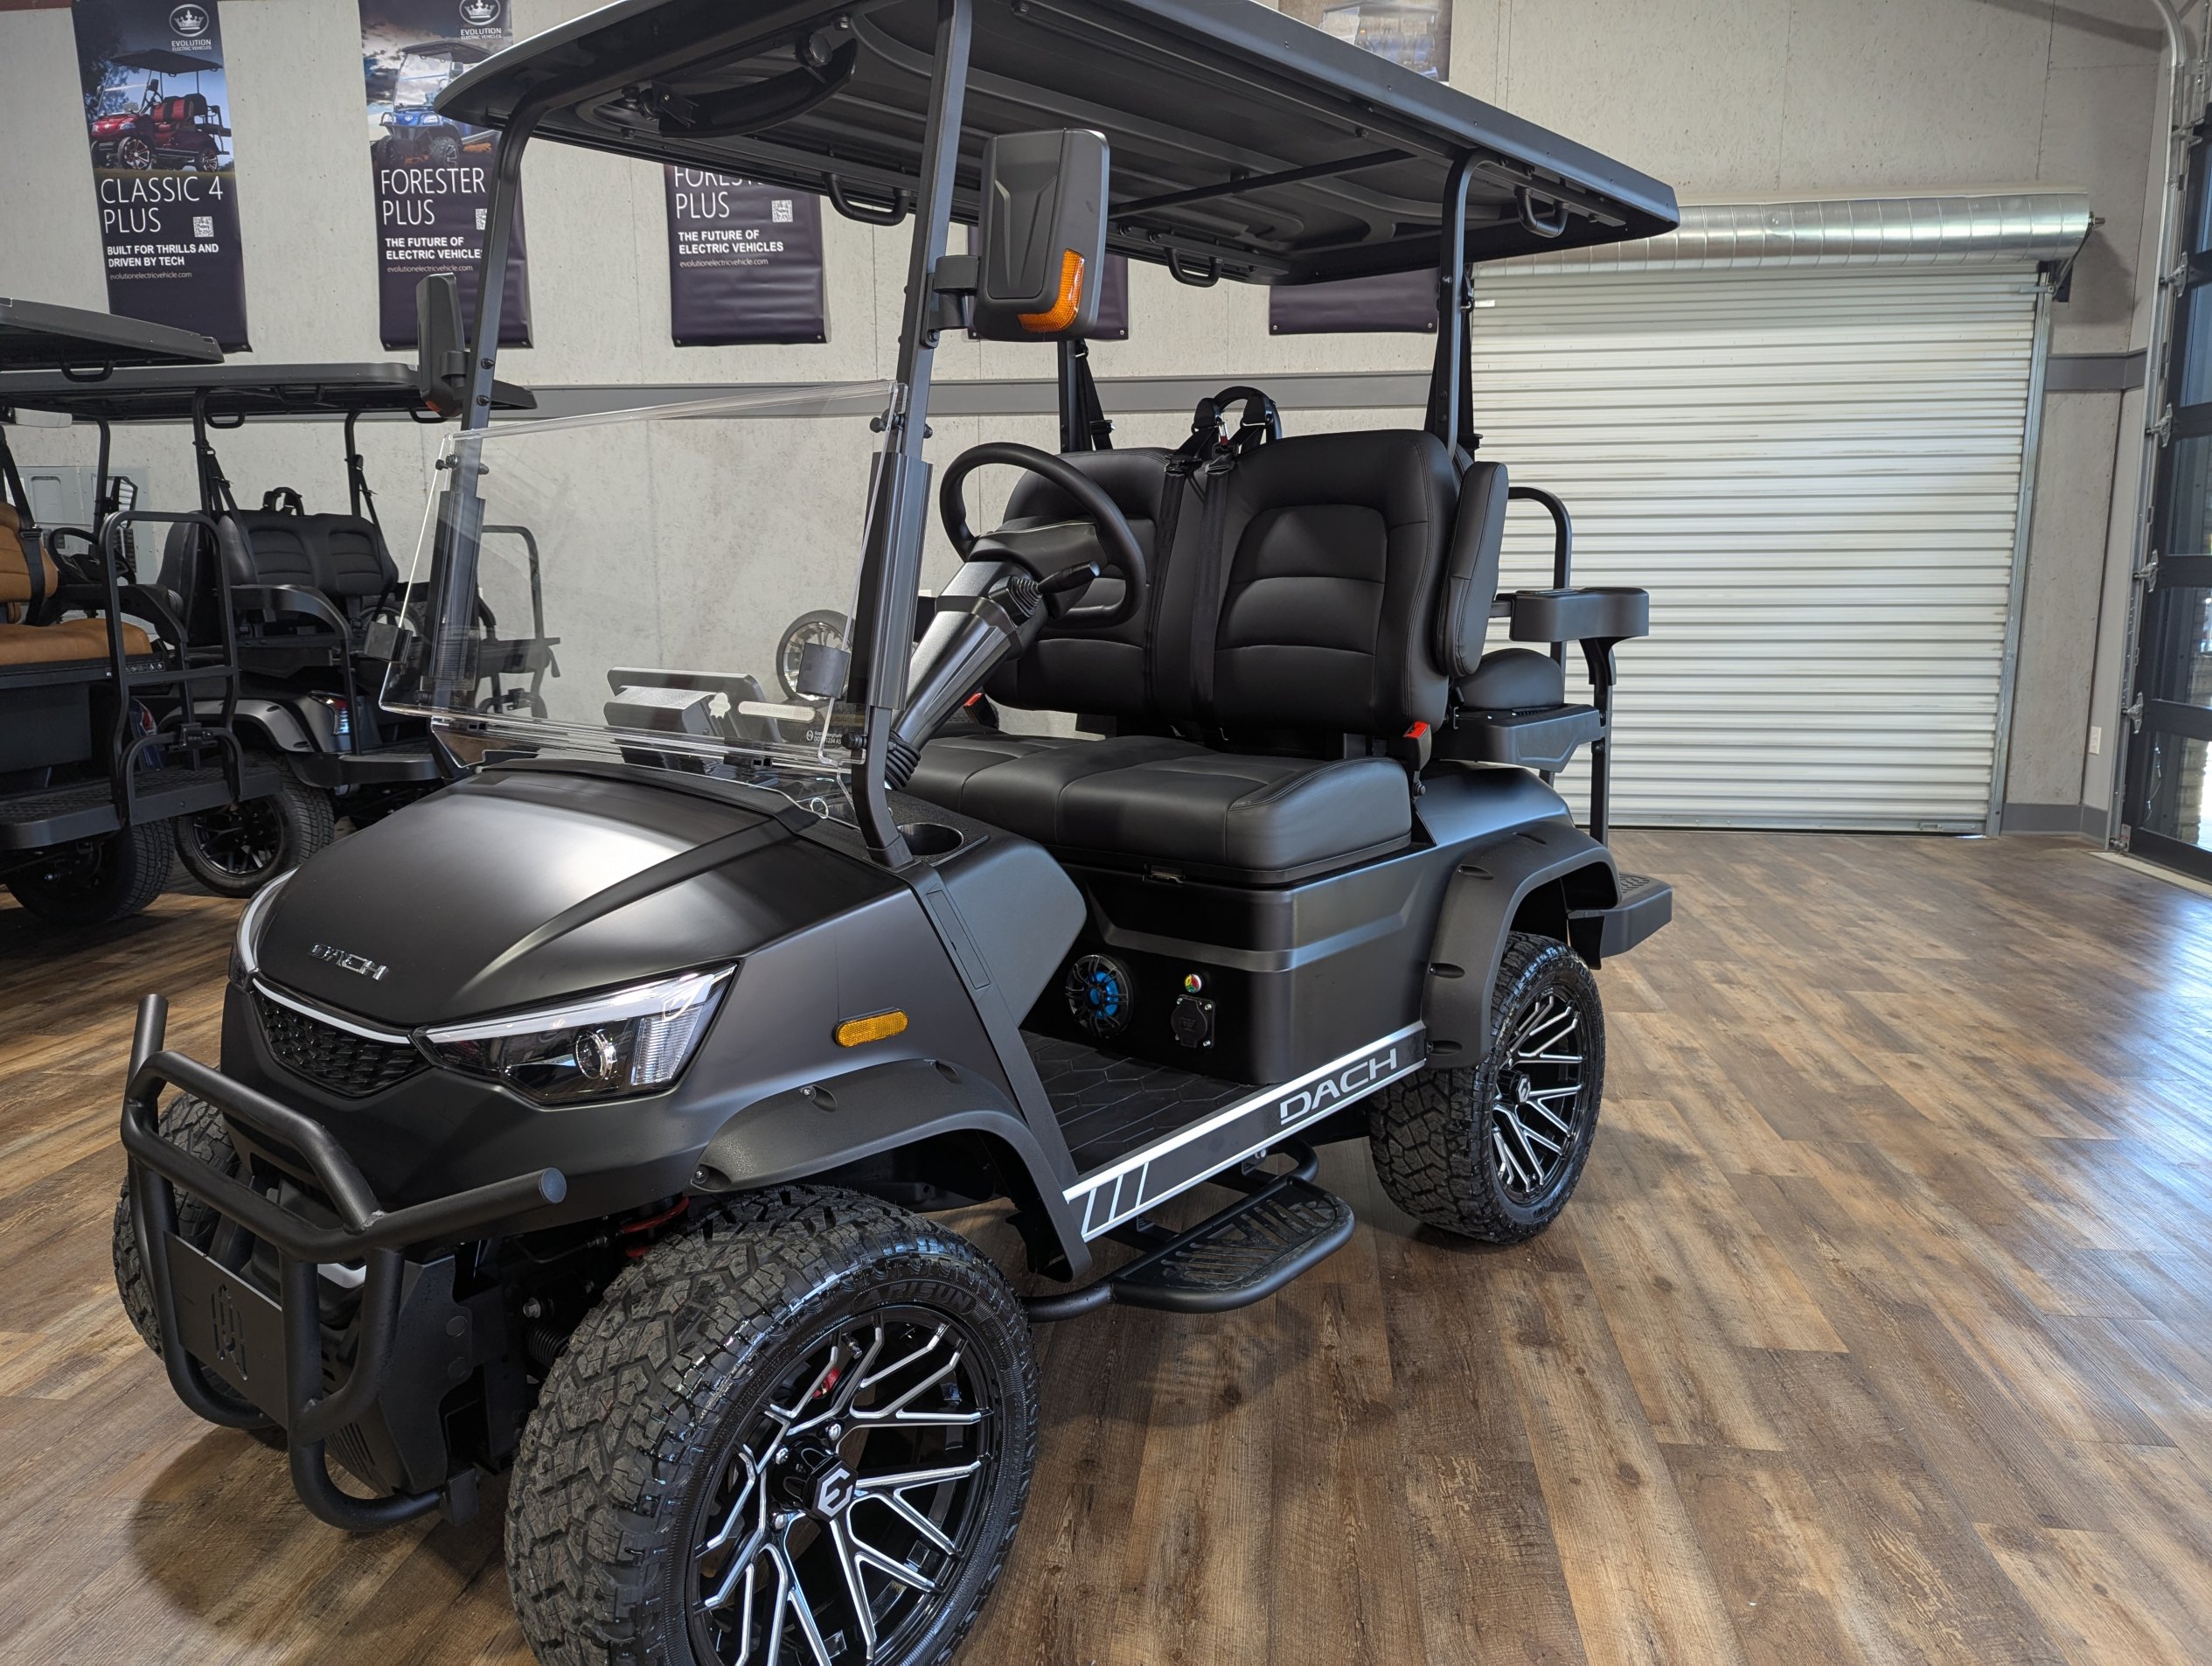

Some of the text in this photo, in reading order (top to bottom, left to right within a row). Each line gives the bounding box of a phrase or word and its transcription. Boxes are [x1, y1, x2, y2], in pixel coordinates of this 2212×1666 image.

[381, 167, 486, 194] FORESTER
[101, 176, 224, 204] CLASSIC 4
[675, 191, 730, 220] PLUS
[382, 199, 435, 226] PLUS
[103, 207, 162, 234] PLUS
[385, 236, 464, 247] THE FUTURE OF
[678, 229, 760, 241] THE FUTURE OF
[107, 243, 219, 255] BUILT FOR THRILLS AND
[678, 241, 784, 254] ELECTRIC VEHICLES
[386, 248, 483, 261] ELECTRIC VEHICLE
[108, 256, 185, 268] DRIVEN BY TECH
[387, 264, 473, 273] evolutionelectricvehicle.com
[679, 258, 769, 268] evolutionelectricvehicle.com
[109, 271, 192, 281] evolutionelectricvehicle.com
[309, 944, 389, 979] DACH
[1279, 1048, 1397, 1126] DACH
